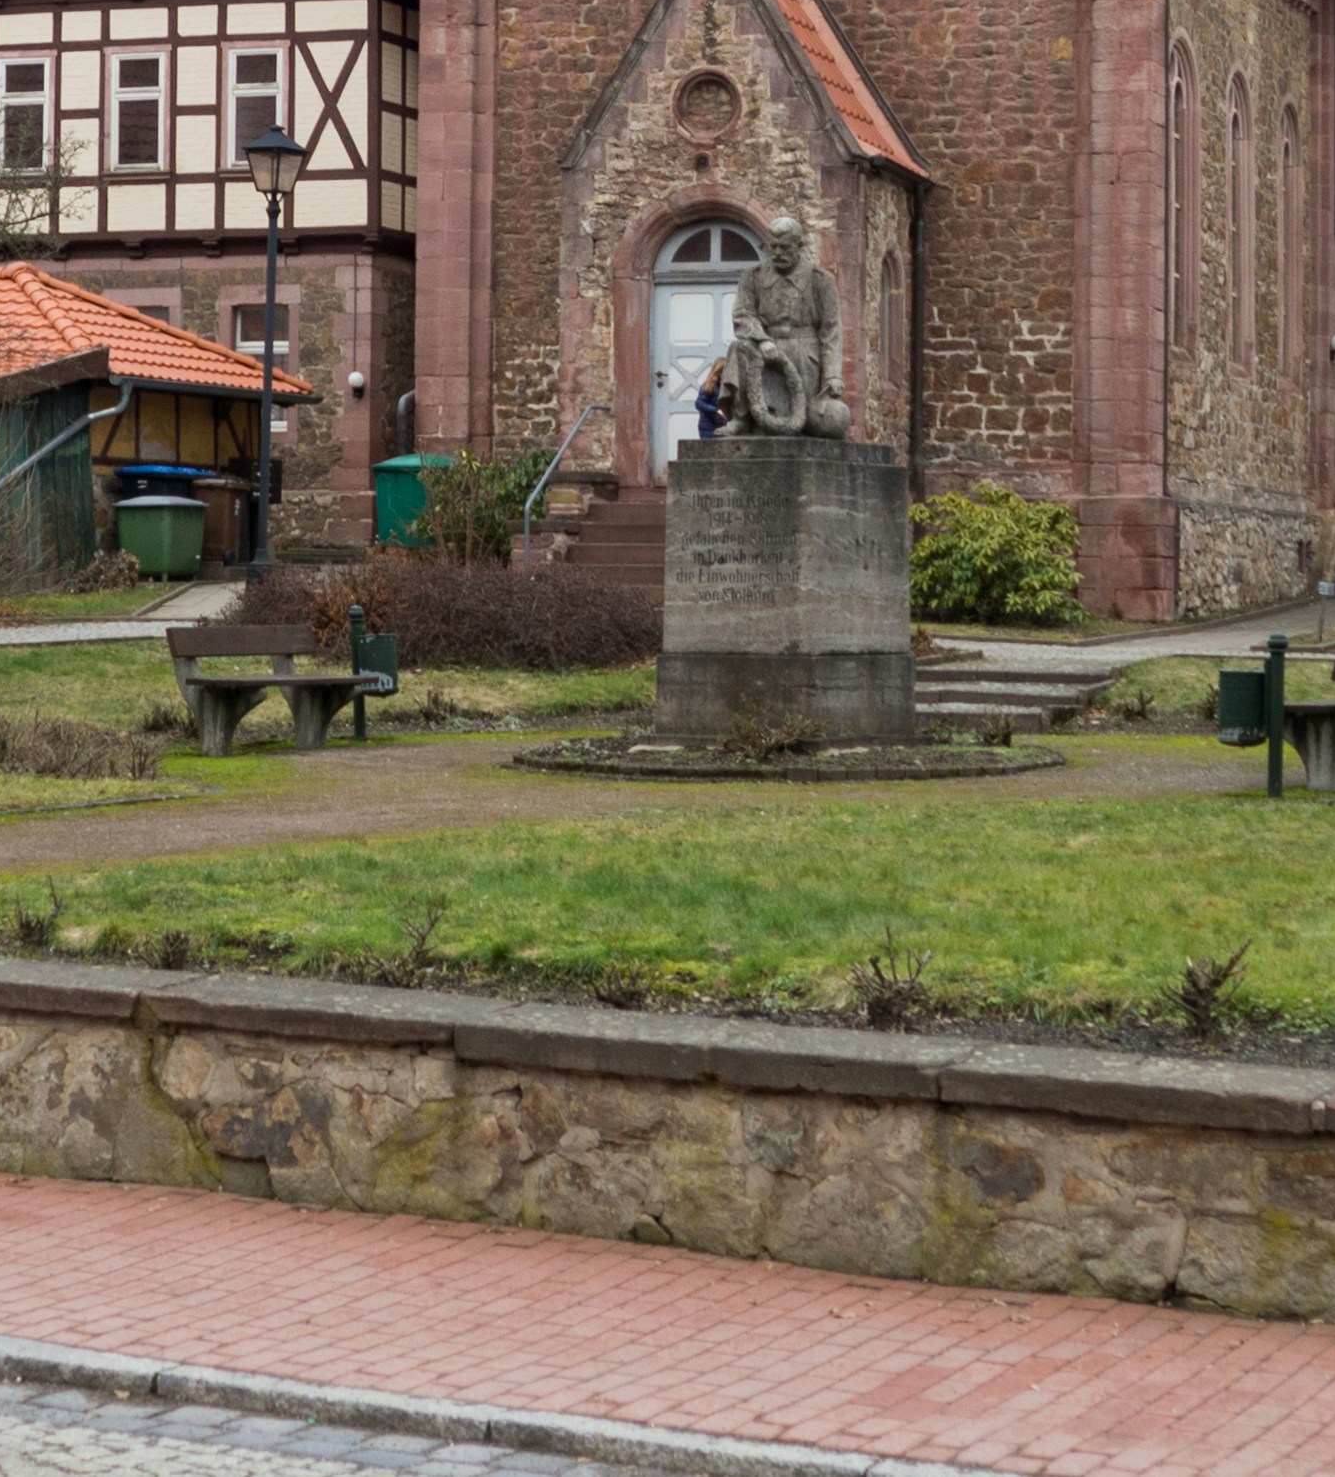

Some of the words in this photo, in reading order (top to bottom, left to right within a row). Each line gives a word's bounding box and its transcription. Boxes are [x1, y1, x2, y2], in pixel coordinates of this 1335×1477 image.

[727, 492, 744, 509] im
[681, 531, 745, 550] gefallenen
[706, 549, 784, 566] Dankbarkeit
[676, 567, 695, 584] die
[698, 567, 800, 584] Einwohnerschaft
